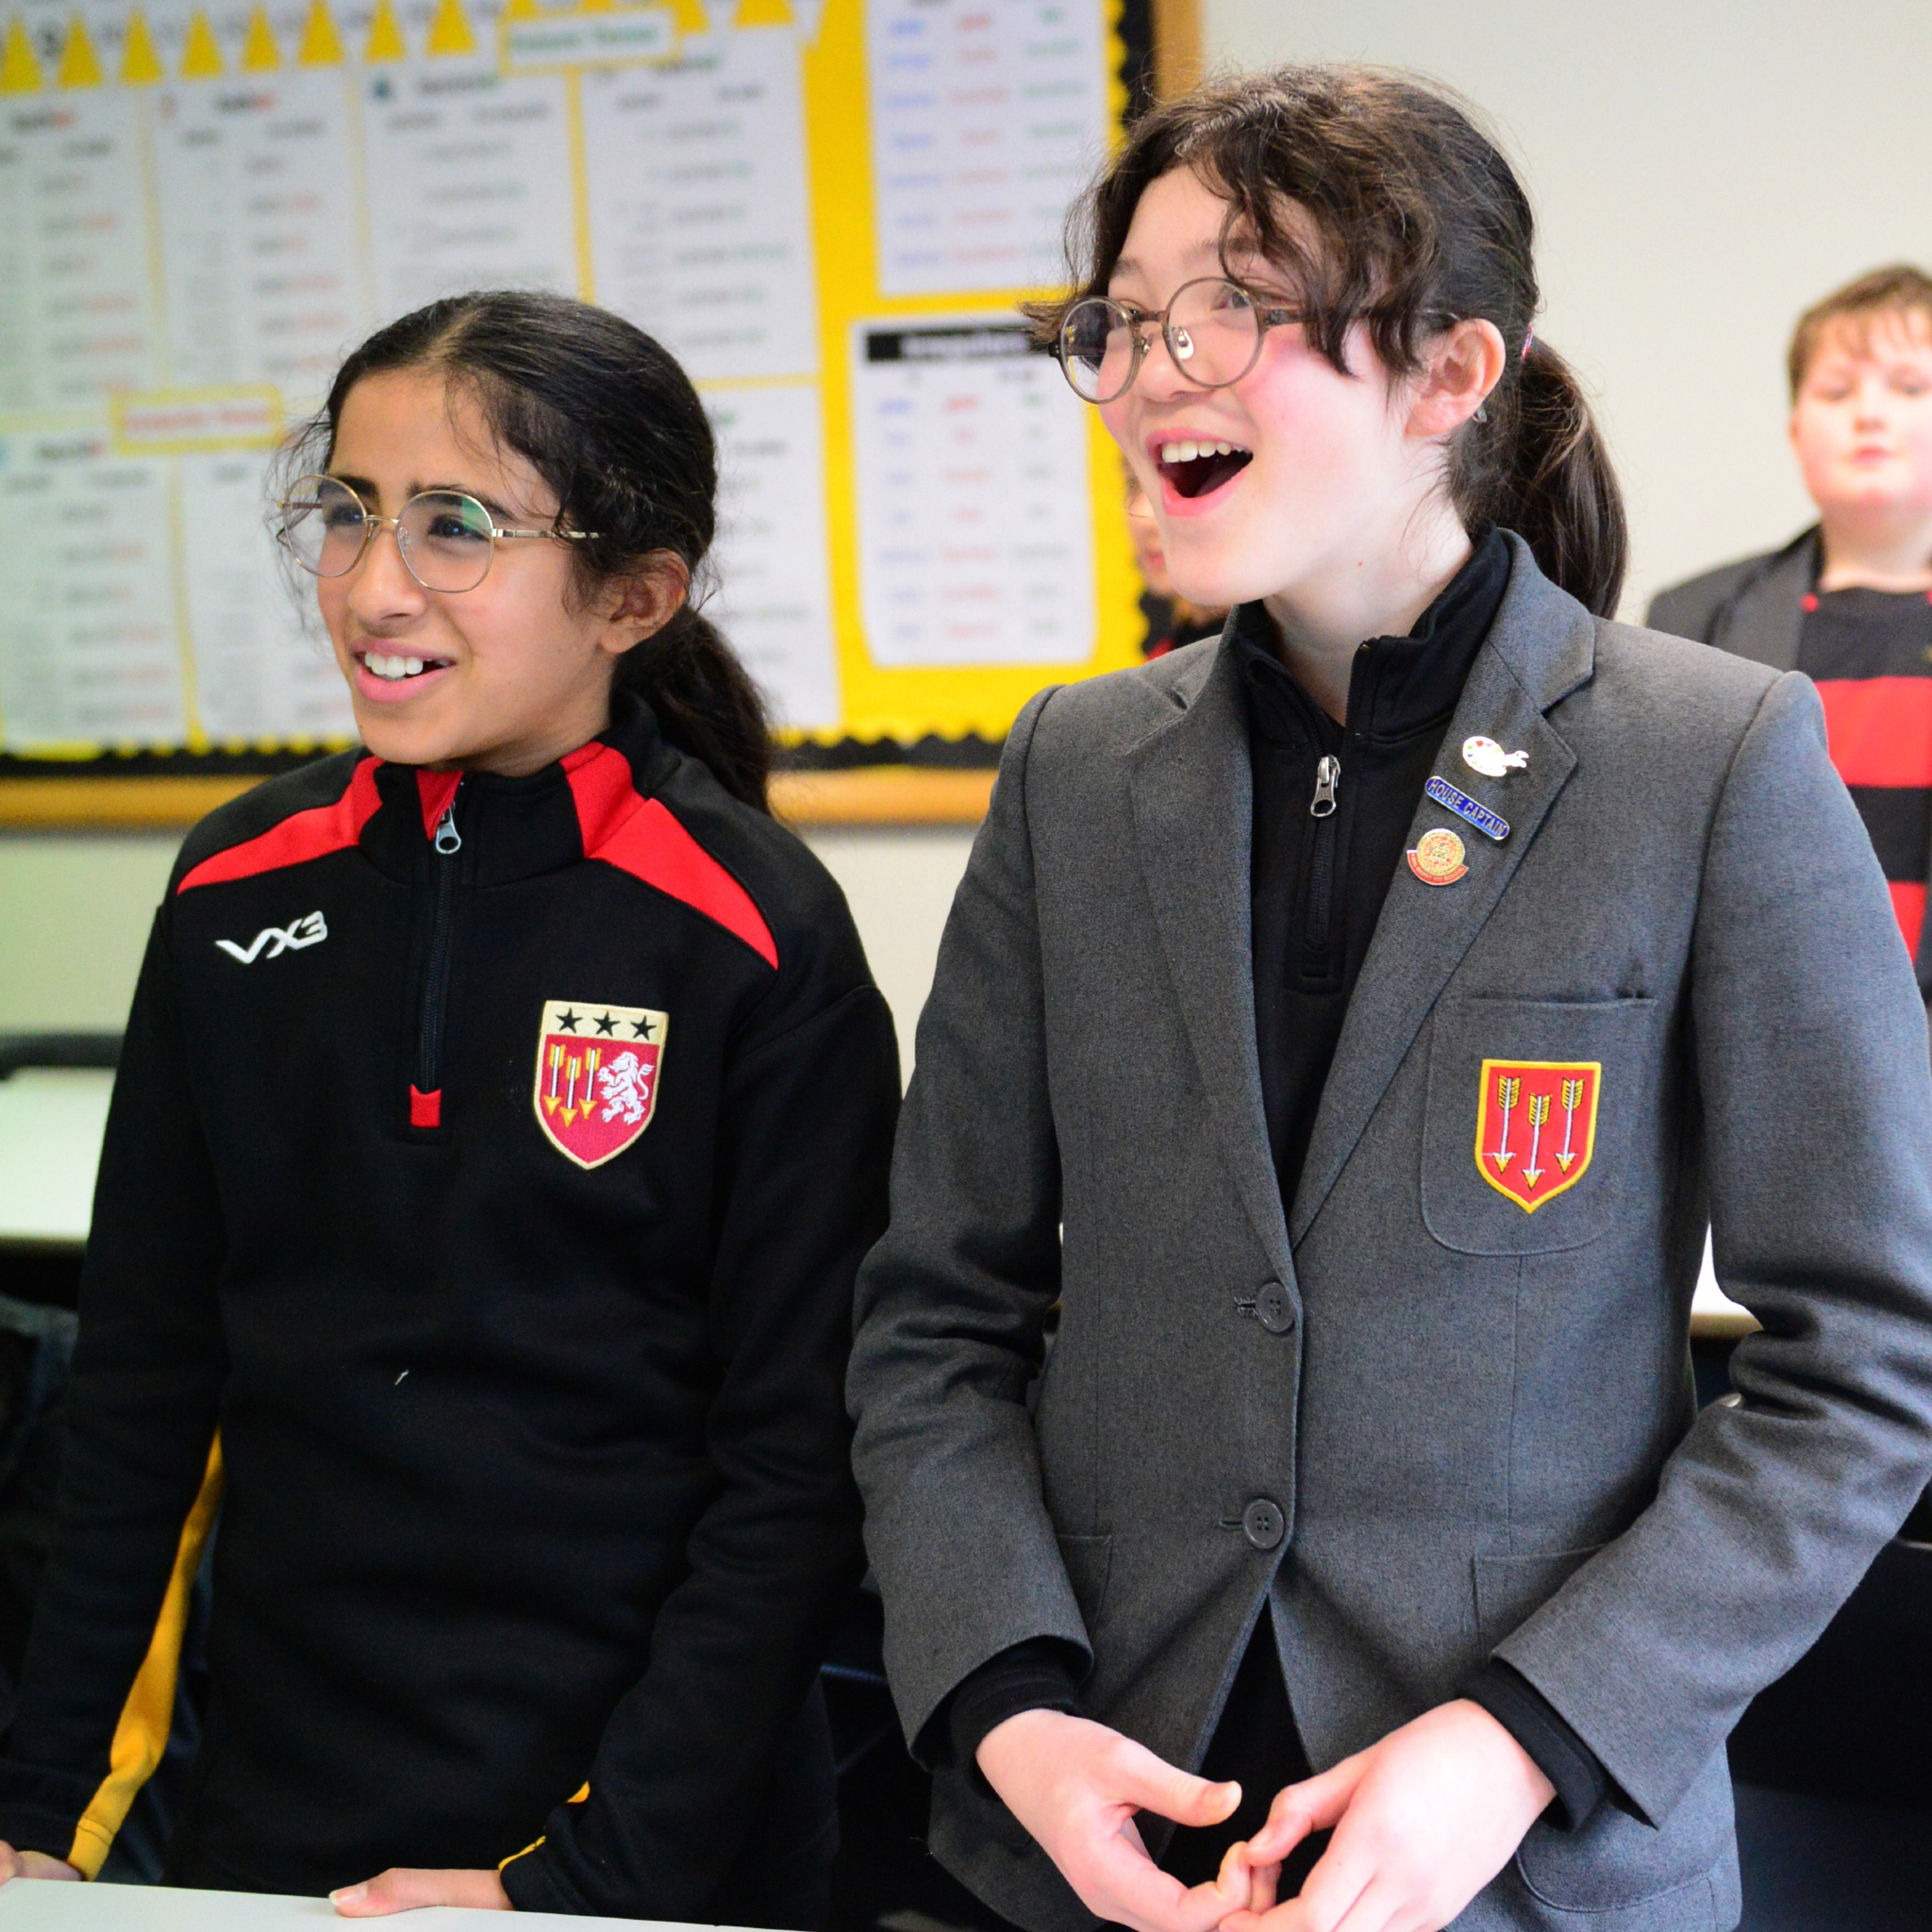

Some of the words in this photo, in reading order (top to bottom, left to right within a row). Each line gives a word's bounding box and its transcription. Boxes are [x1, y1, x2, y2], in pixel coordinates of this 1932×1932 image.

[1427, 778, 1464, 808] HOUSE
[1463, 802, 1507, 837] CAPTAIN
[215, 910, 327, 964] VX3
